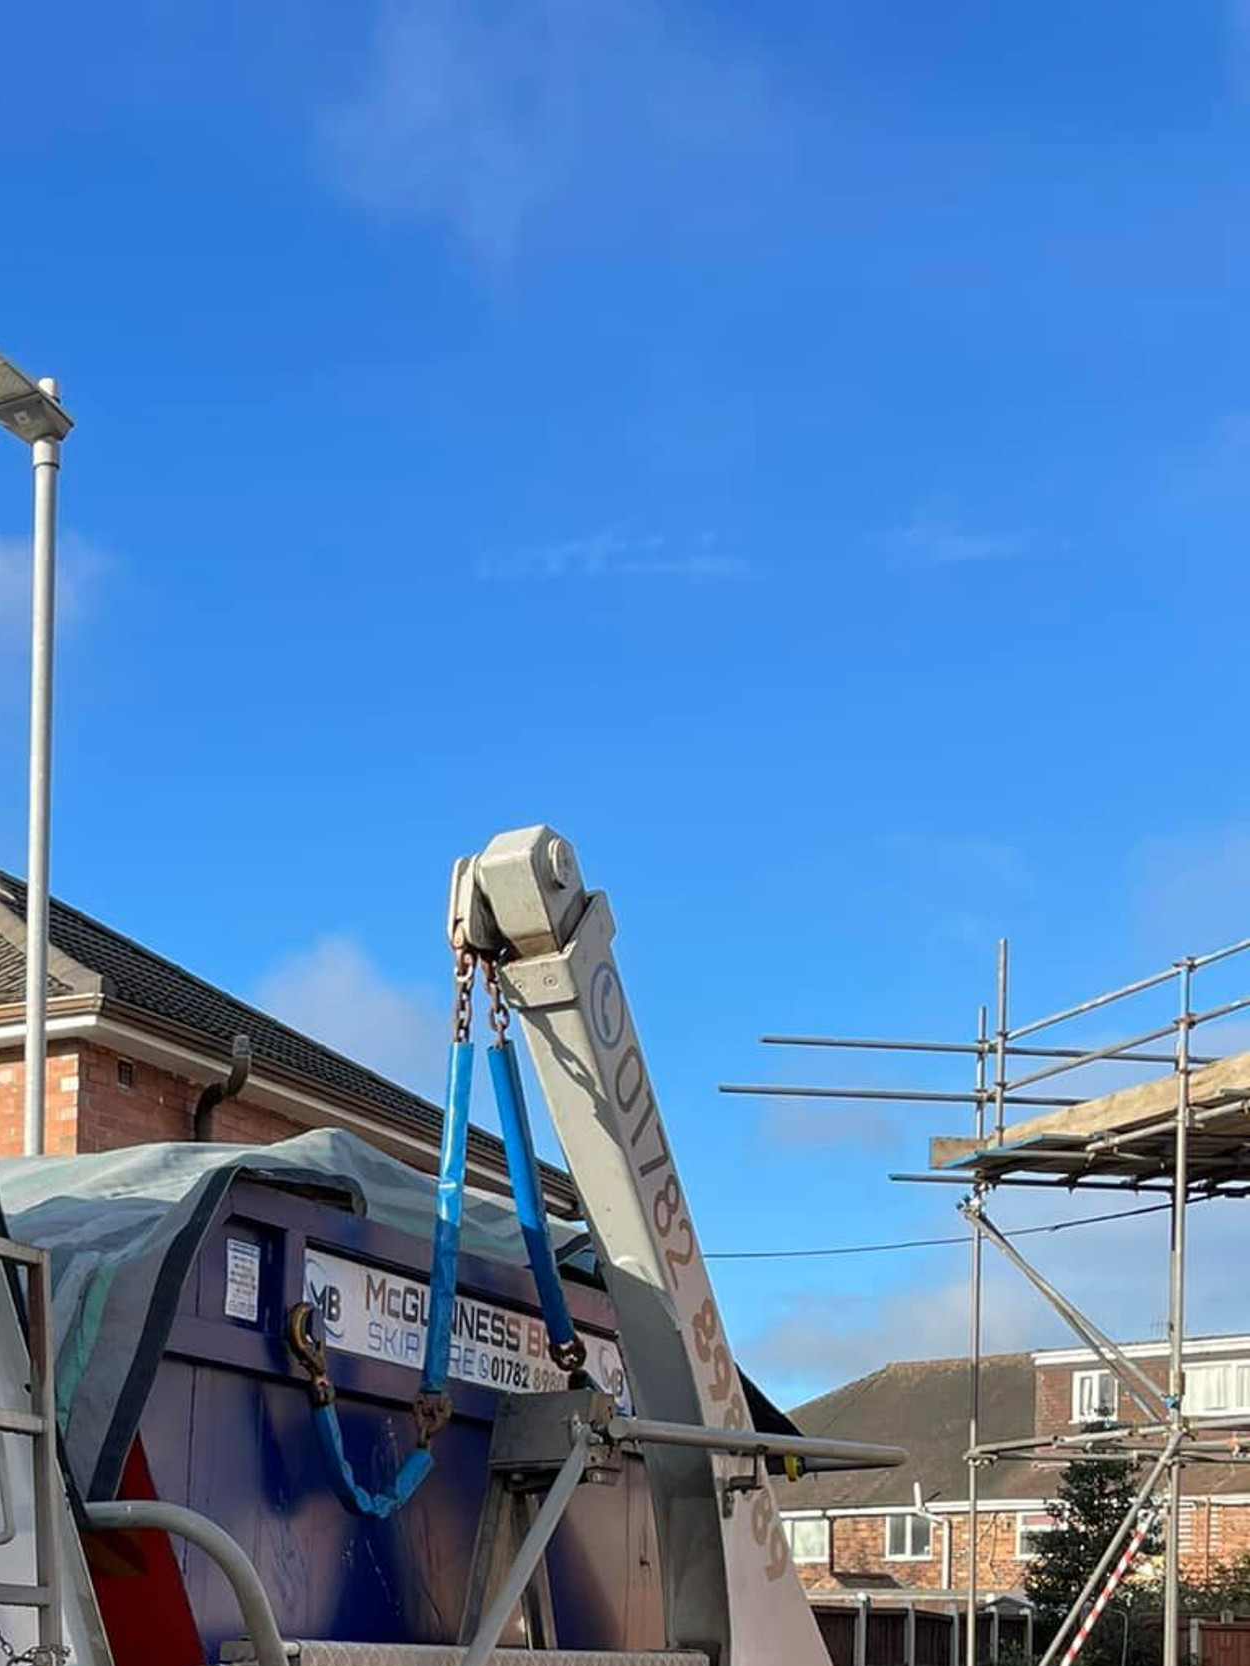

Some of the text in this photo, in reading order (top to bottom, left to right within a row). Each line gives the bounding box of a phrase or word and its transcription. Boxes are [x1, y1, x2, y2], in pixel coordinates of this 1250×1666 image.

[616, 1045, 694, 1291] 01782
[365, 1273, 521, 1352] McGUNESS
[368, 1321, 420, 1360] SKIP
[491, 1356, 531, 1389] 01782
[692, 1298, 788, 1582] 89889
